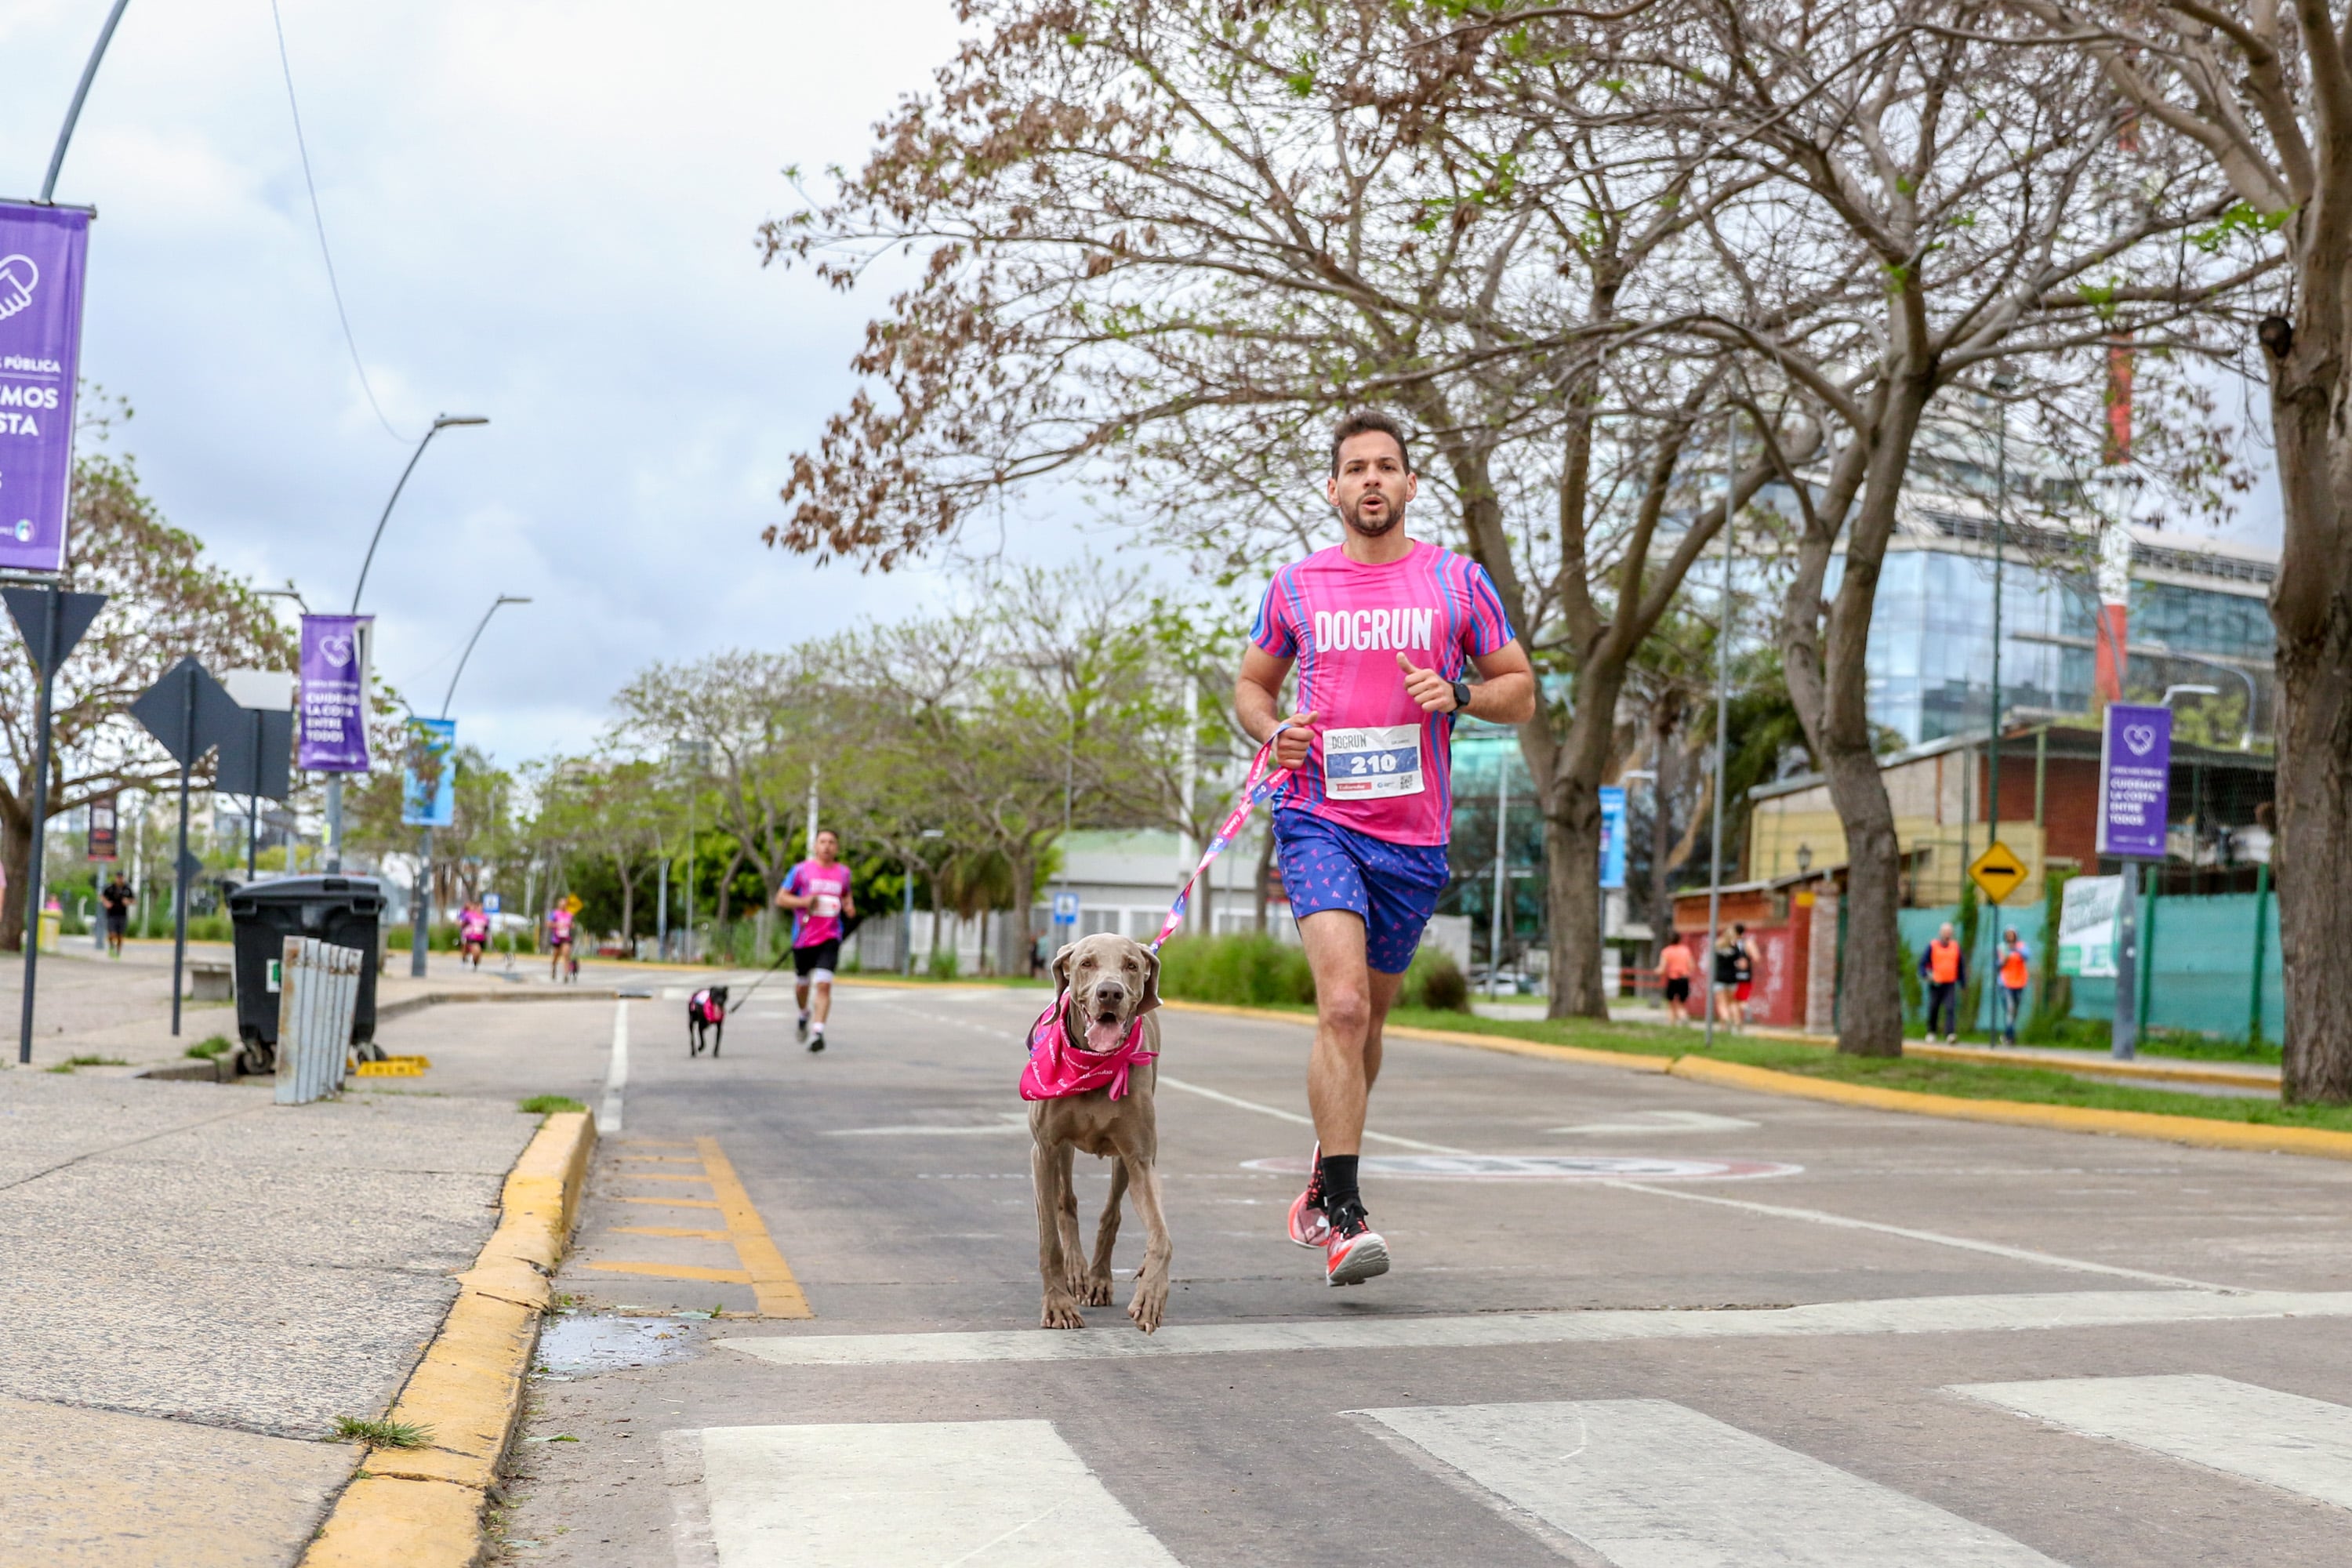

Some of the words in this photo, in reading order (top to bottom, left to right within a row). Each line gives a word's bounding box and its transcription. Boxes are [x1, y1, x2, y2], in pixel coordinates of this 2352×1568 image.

[4, 354, 61, 373] PÚBLICA
[0, 384, 59, 409] MOS
[1315, 608, 1433, 653] DOGRUN
[1332, 735, 1367, 750] DOGRUN
[1350, 753, 1396, 775] 210
